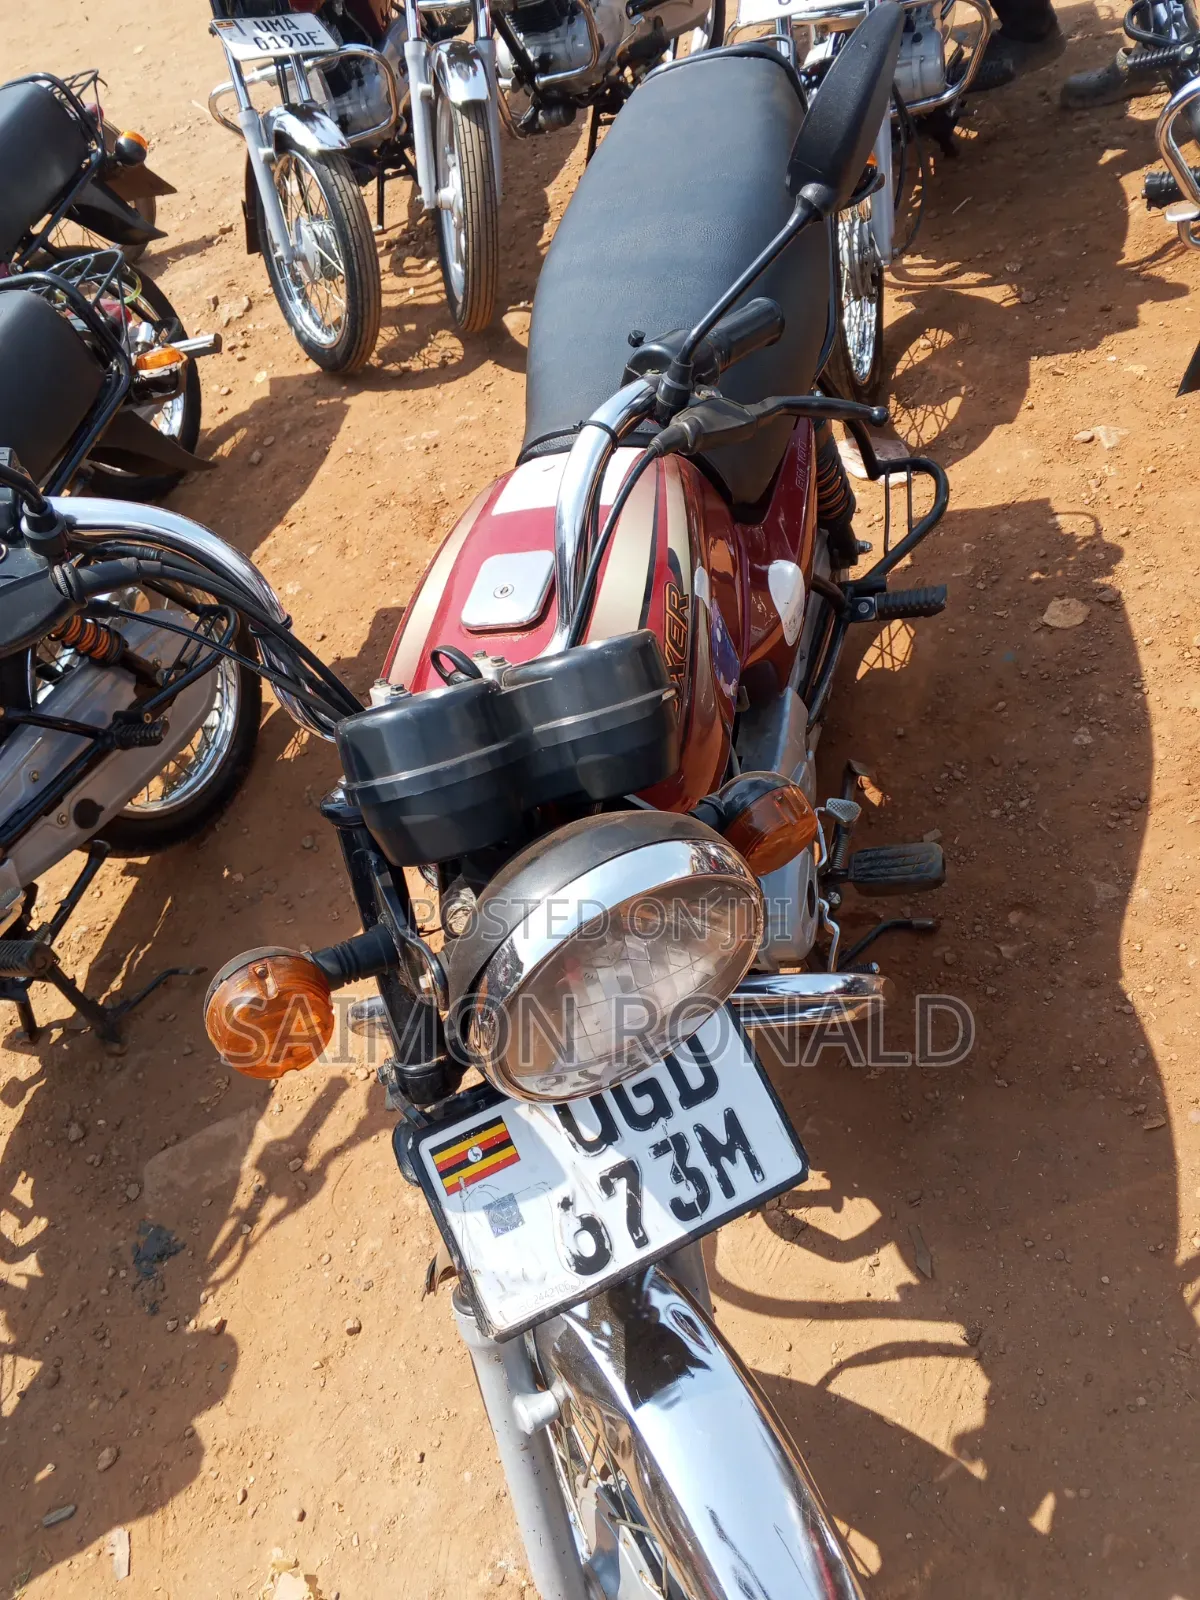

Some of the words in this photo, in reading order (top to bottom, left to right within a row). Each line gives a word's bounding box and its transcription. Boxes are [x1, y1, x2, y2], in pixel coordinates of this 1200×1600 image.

[253, 16, 299, 33] UMA
[664, 582, 689, 708] XER
[556, 1107, 765, 1277] 673M
